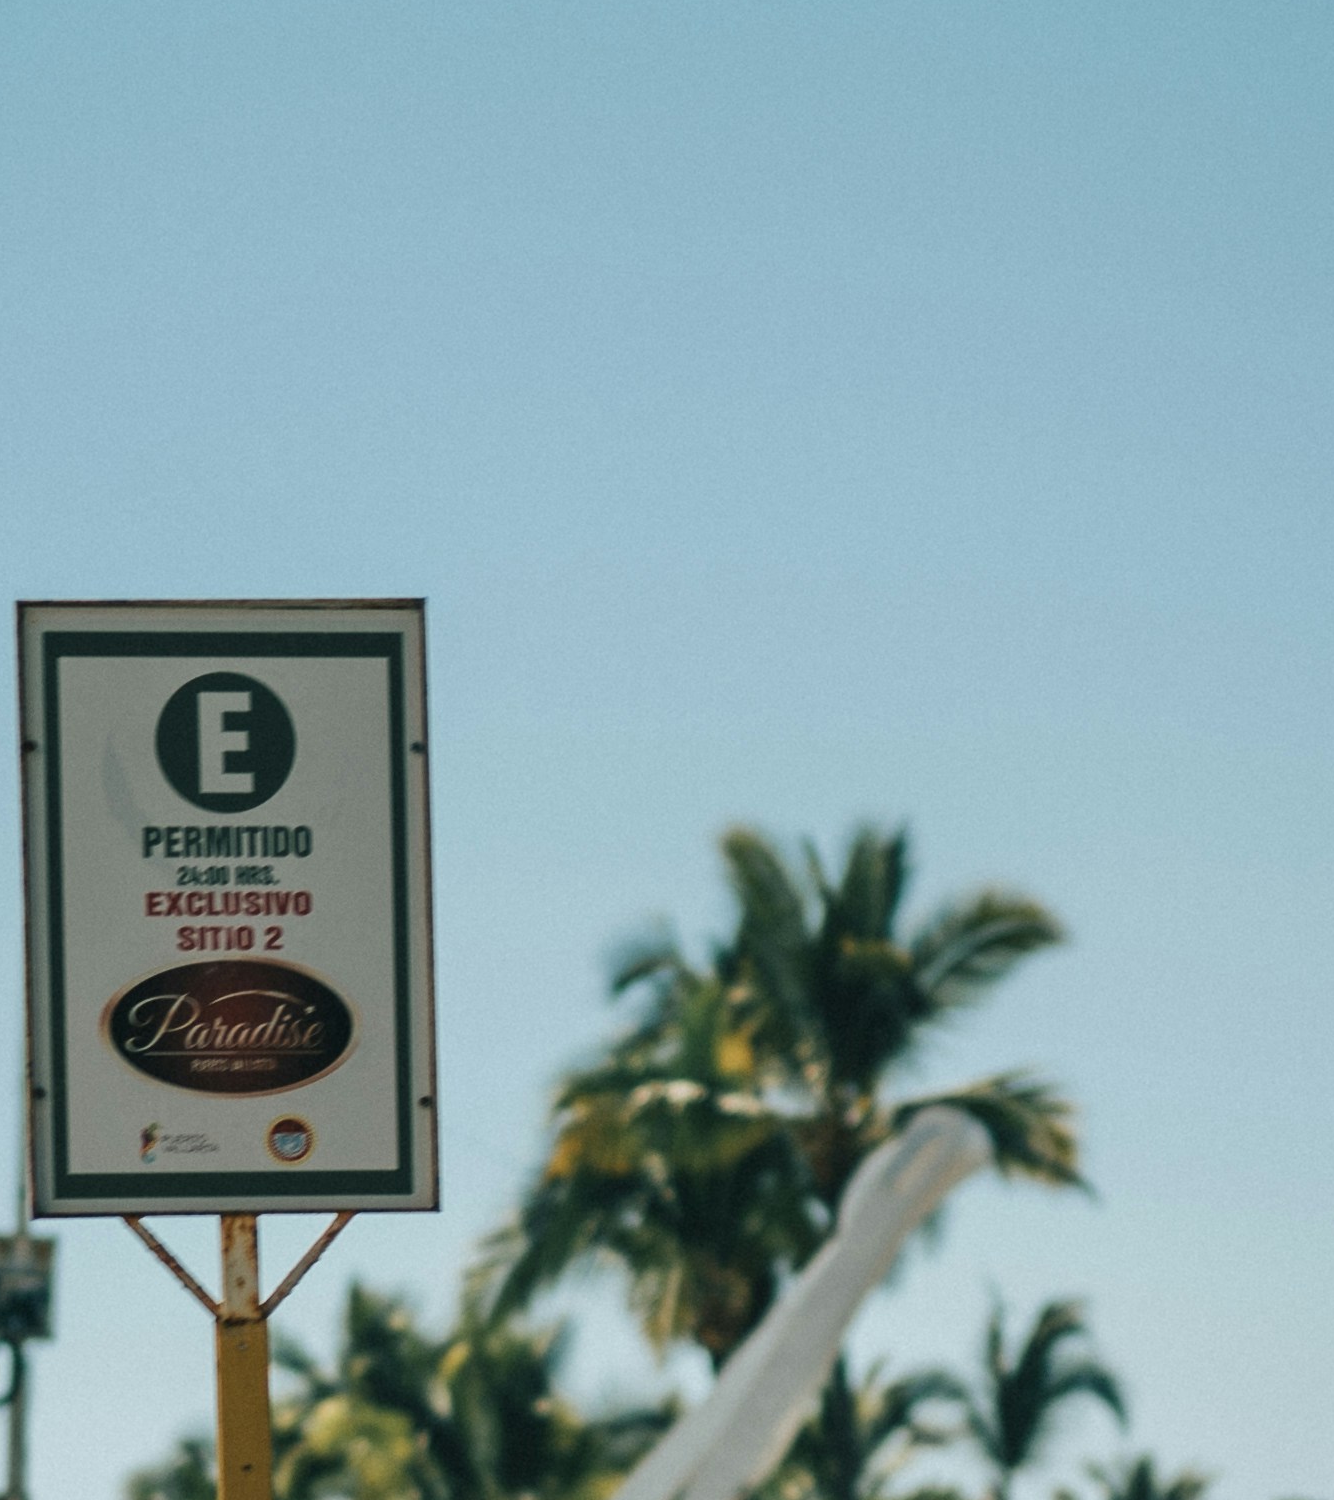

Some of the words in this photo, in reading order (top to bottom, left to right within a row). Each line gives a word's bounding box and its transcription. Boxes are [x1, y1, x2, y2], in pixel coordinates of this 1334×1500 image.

[196, 690, 255, 794] E
[142, 826, 312, 859] PERMITIDO
[144, 891, 312, 917] EXCLUSIVO
[176, 925, 255, 952] SITIO
[263, 925, 284, 951] 2
[124, 992, 326, 1053] Paradise
